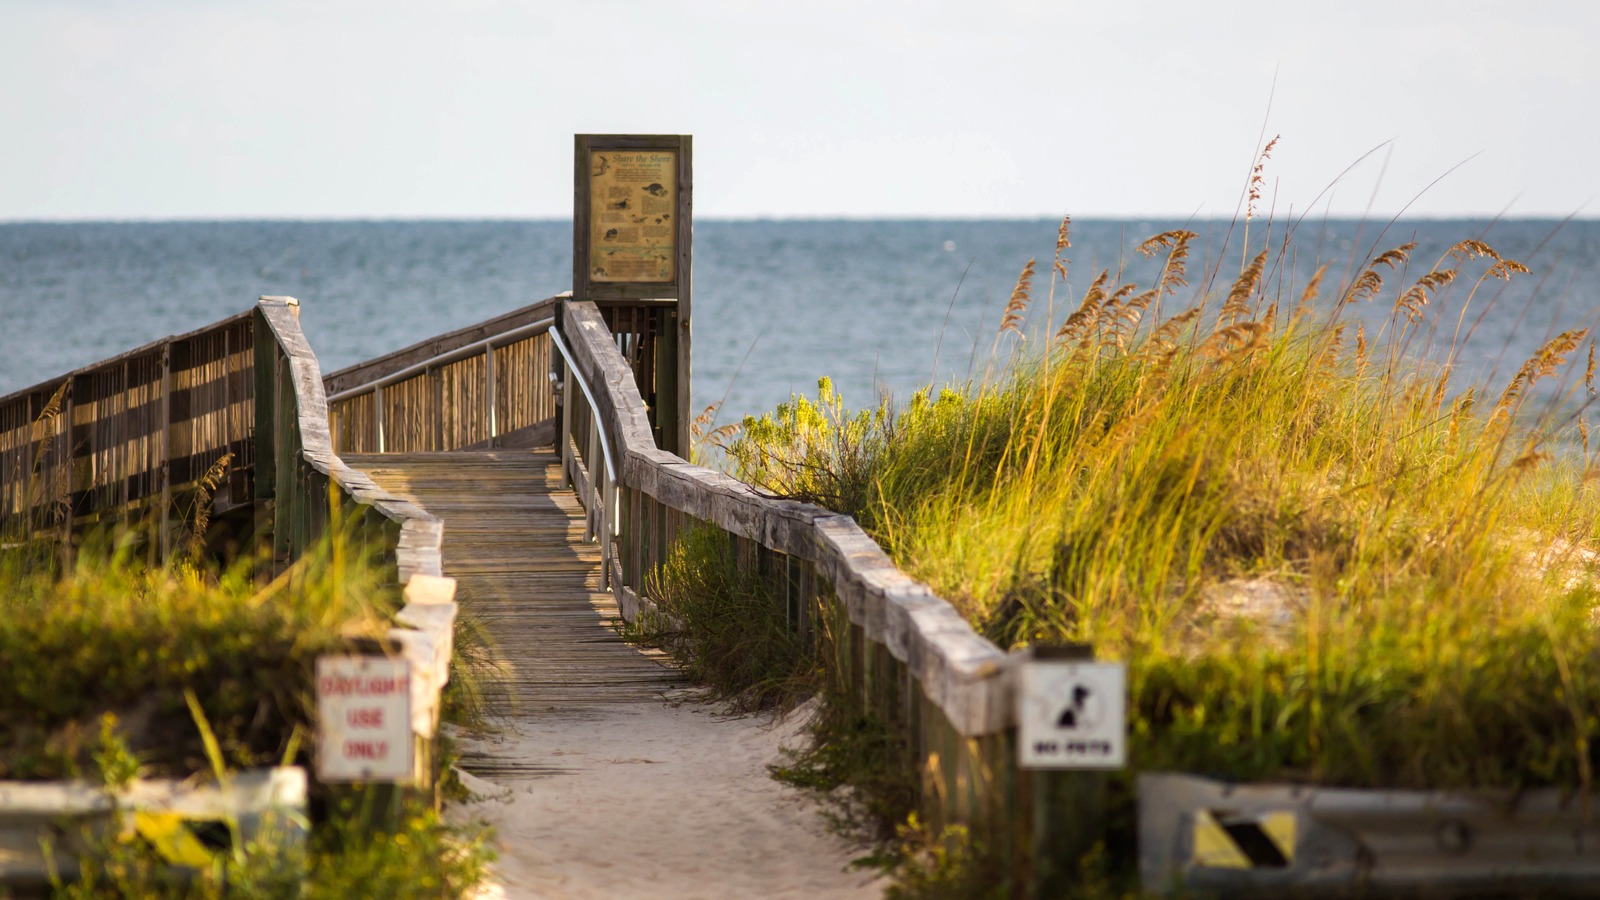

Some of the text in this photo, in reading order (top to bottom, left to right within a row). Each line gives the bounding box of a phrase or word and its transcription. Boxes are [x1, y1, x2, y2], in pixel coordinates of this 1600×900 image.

[612, 154, 671, 163] Share the Shore
[321, 676, 410, 696] DAYLIGHT
[346, 708, 383, 728] USE
[343, 740, 389, 760] ONLY
[1034, 740, 1112, 755] NO PETS
